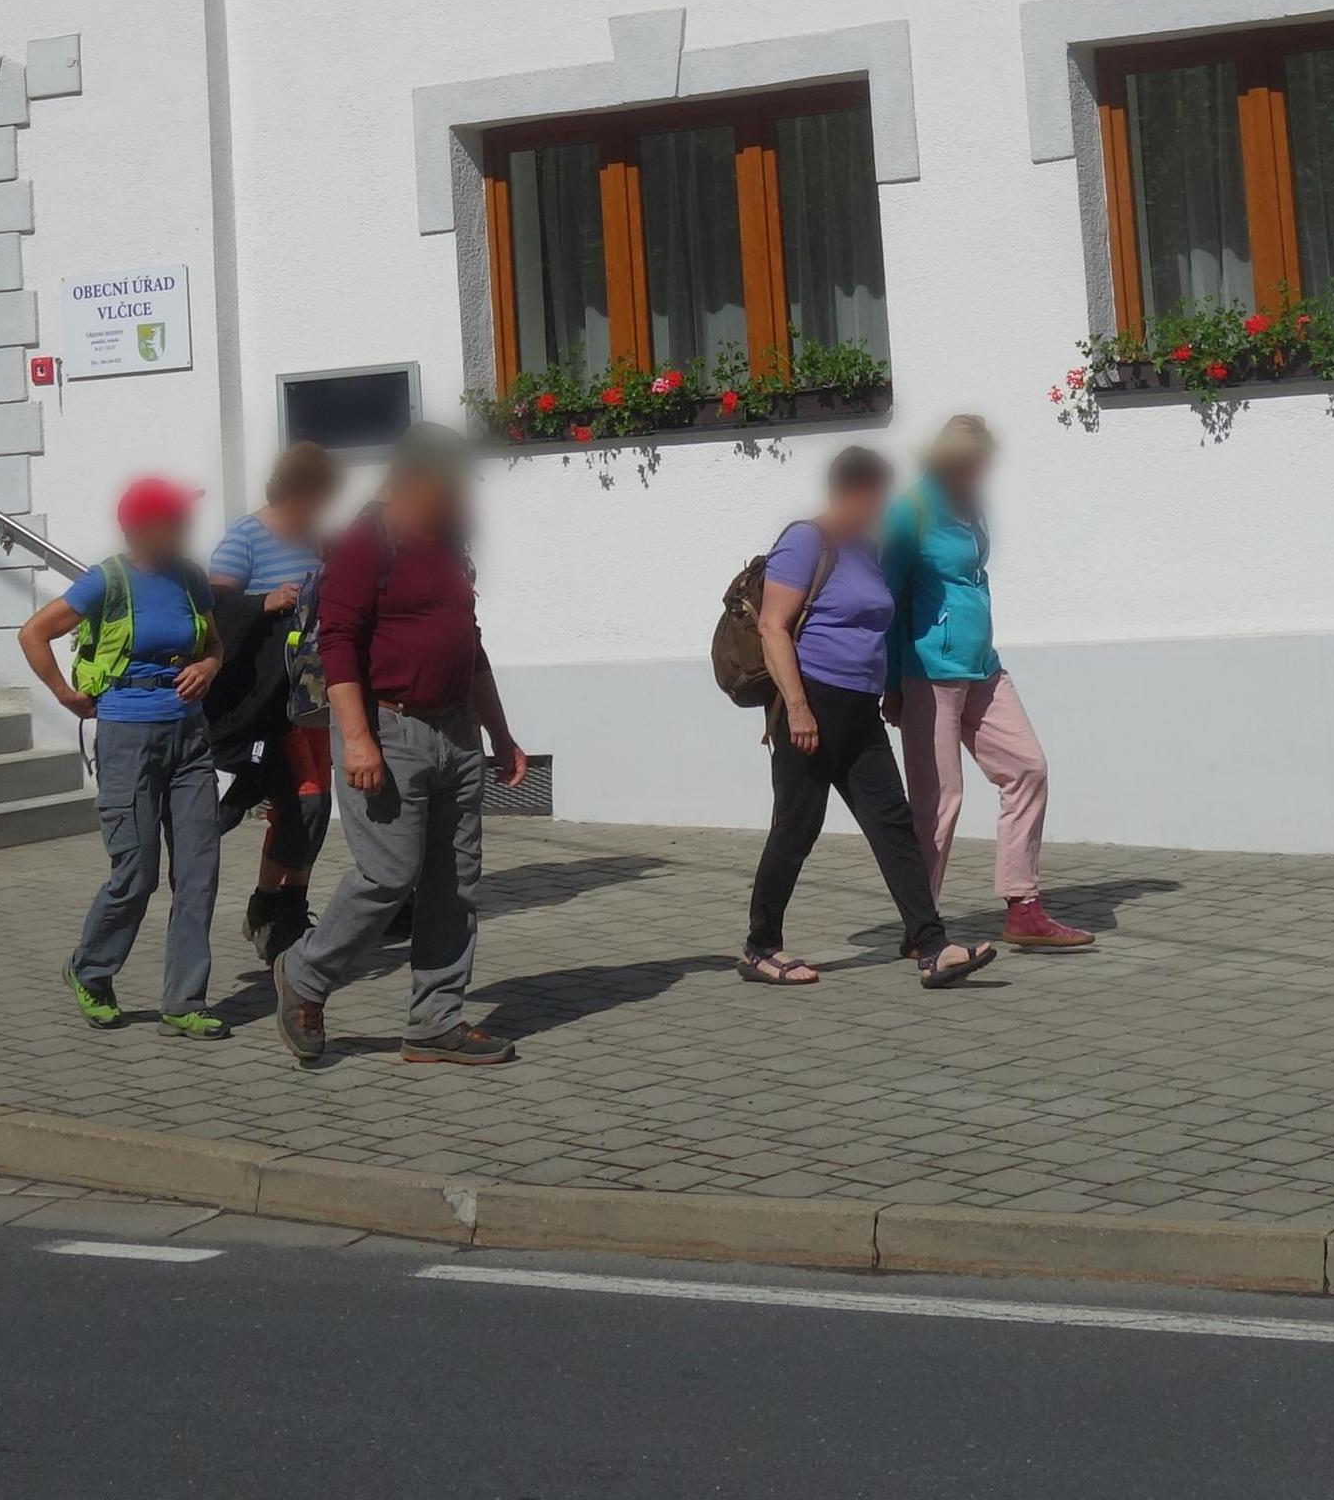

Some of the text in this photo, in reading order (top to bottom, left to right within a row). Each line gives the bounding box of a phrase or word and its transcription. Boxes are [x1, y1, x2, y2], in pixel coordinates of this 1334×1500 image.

[73, 276, 175, 300] OBECNÍ ÚŘAD
[97, 301, 153, 320] VLČICE
